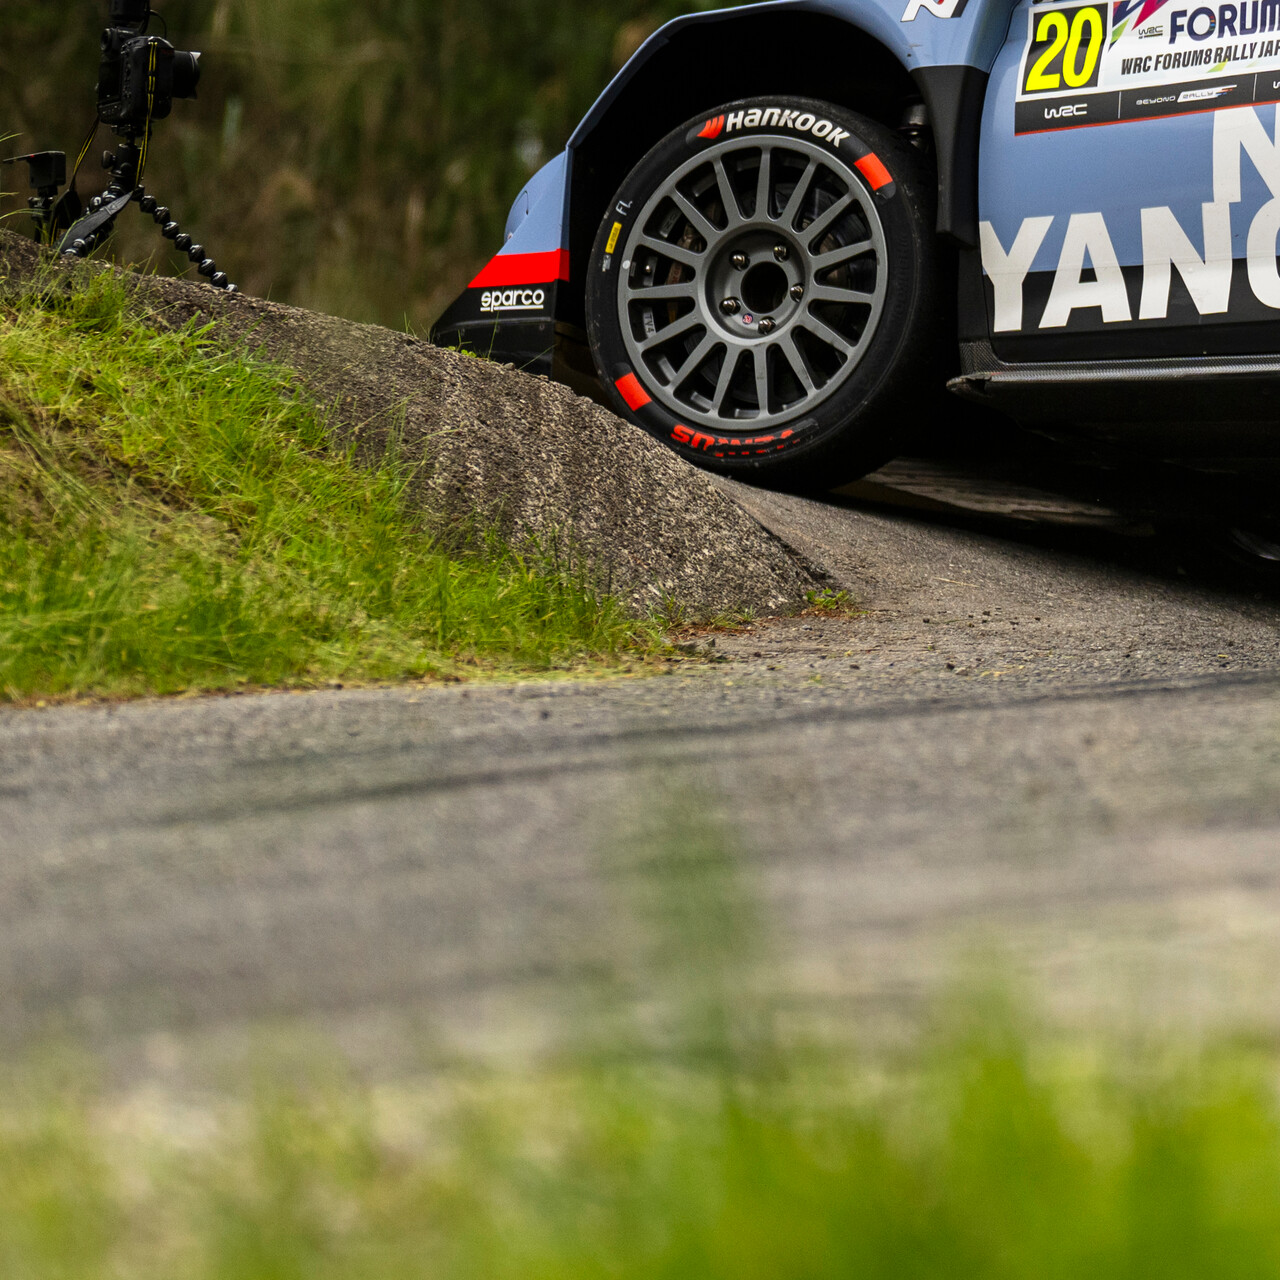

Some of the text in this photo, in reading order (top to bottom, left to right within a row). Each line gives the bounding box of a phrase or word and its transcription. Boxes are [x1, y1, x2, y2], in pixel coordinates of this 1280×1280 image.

[1025, 7, 1103, 91] 20
[1121, 56, 1152, 75] WRC
[1154, 47, 1212, 72] FORUM8
[1214, 40, 1257, 63] RALLY
[1044, 104, 1087, 119] WRC
[1136, 95, 1176, 105] BEYOND
[481, 289, 545, 312] sparco
